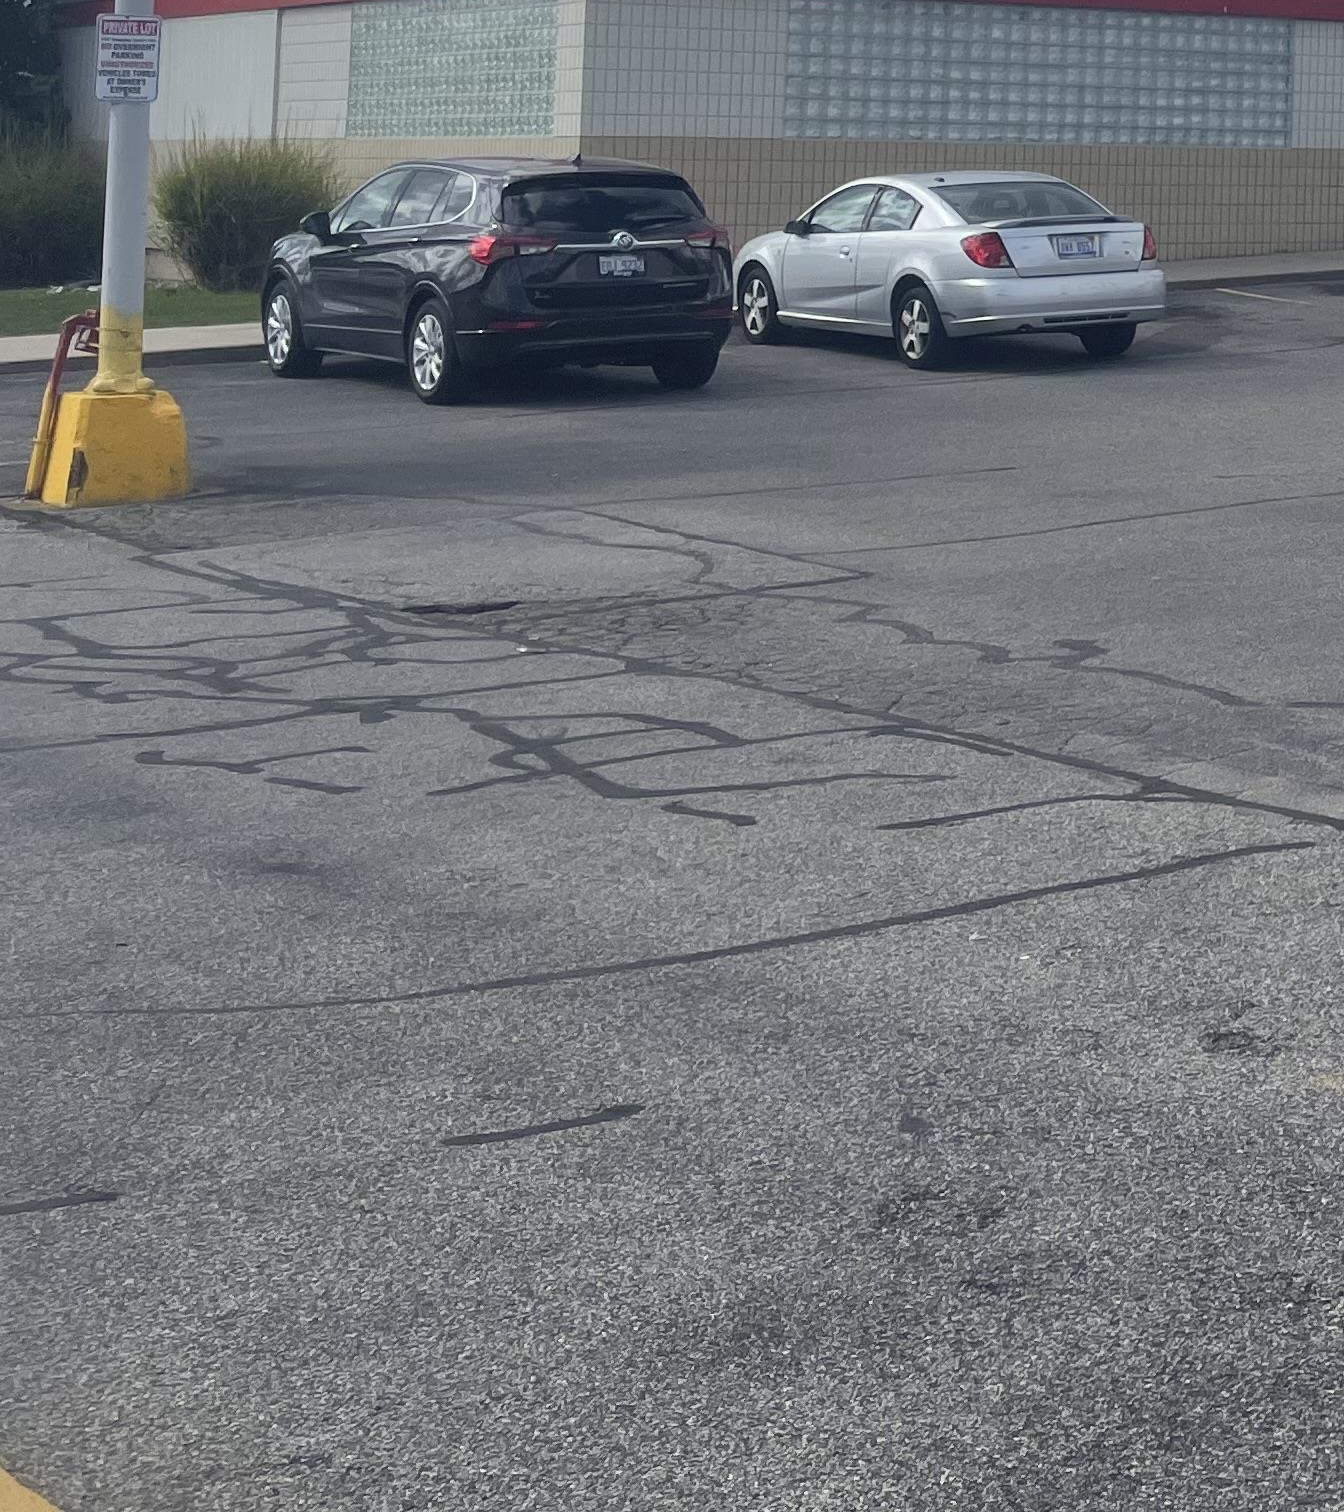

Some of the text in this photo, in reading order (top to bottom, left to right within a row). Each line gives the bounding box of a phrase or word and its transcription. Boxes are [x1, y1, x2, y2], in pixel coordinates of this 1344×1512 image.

[103, 21, 157, 35] PRIVATE LOT
[111, 51, 145, 59] PARKING
